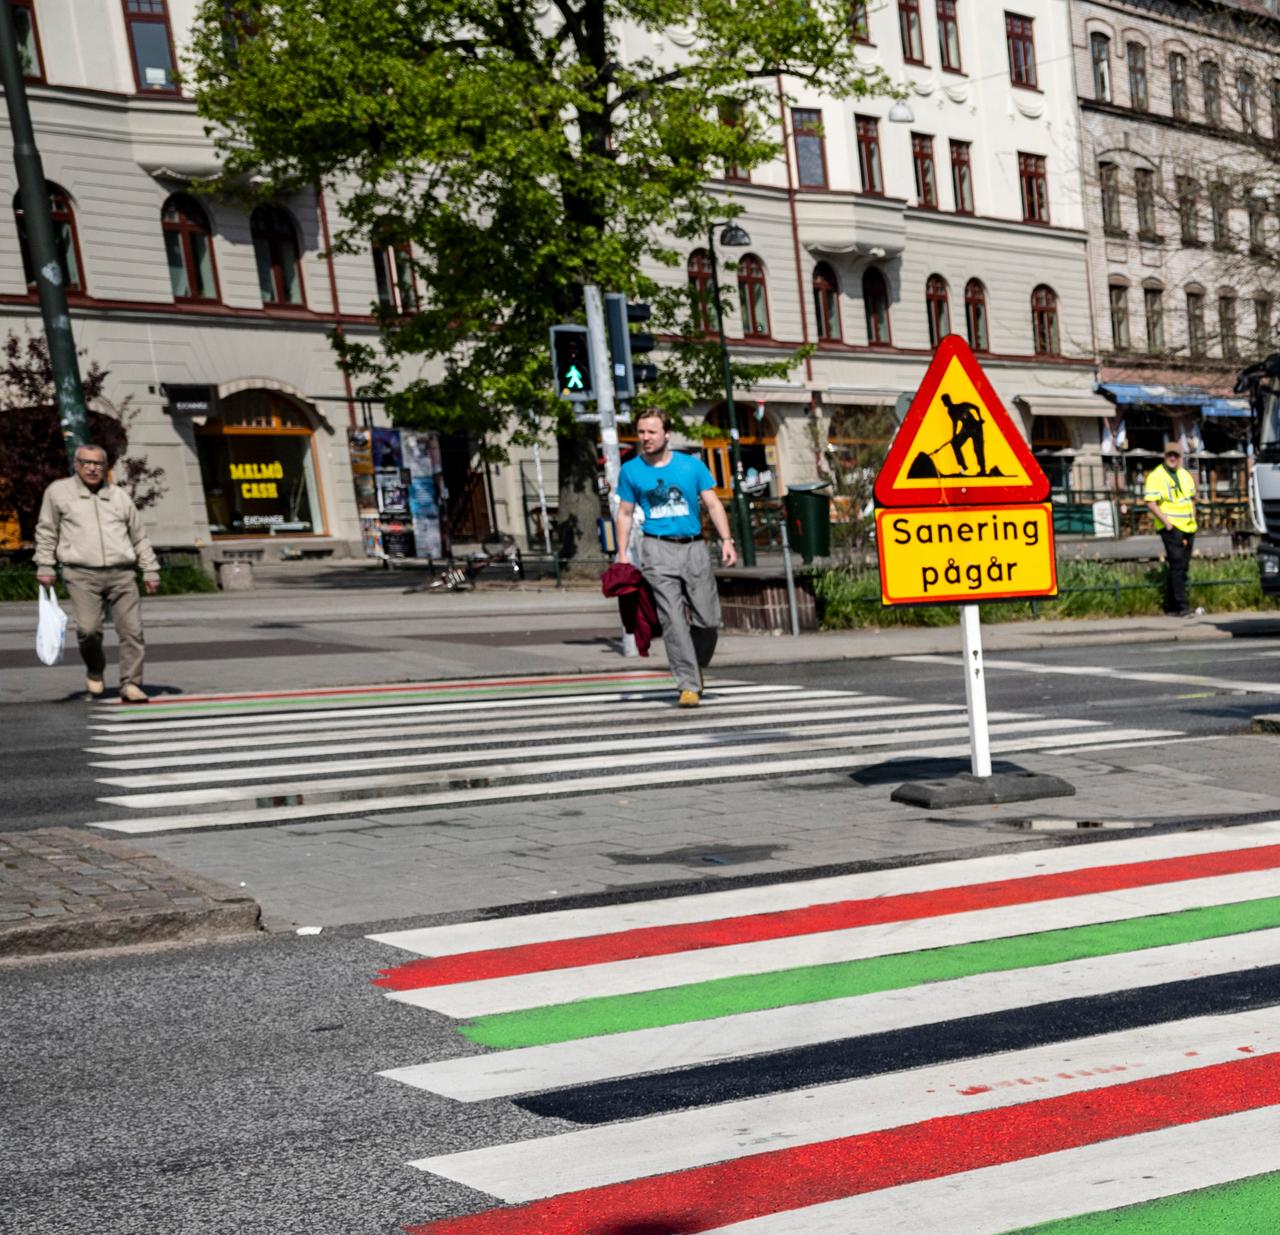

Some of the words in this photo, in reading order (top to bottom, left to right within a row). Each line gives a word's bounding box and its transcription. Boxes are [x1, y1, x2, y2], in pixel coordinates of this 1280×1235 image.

[229, 460, 284, 480] MALMÖ
[240, 482, 278, 499] CASH
[892, 514, 1039, 546] Sanering
[921, 556, 1018, 593] pågår
